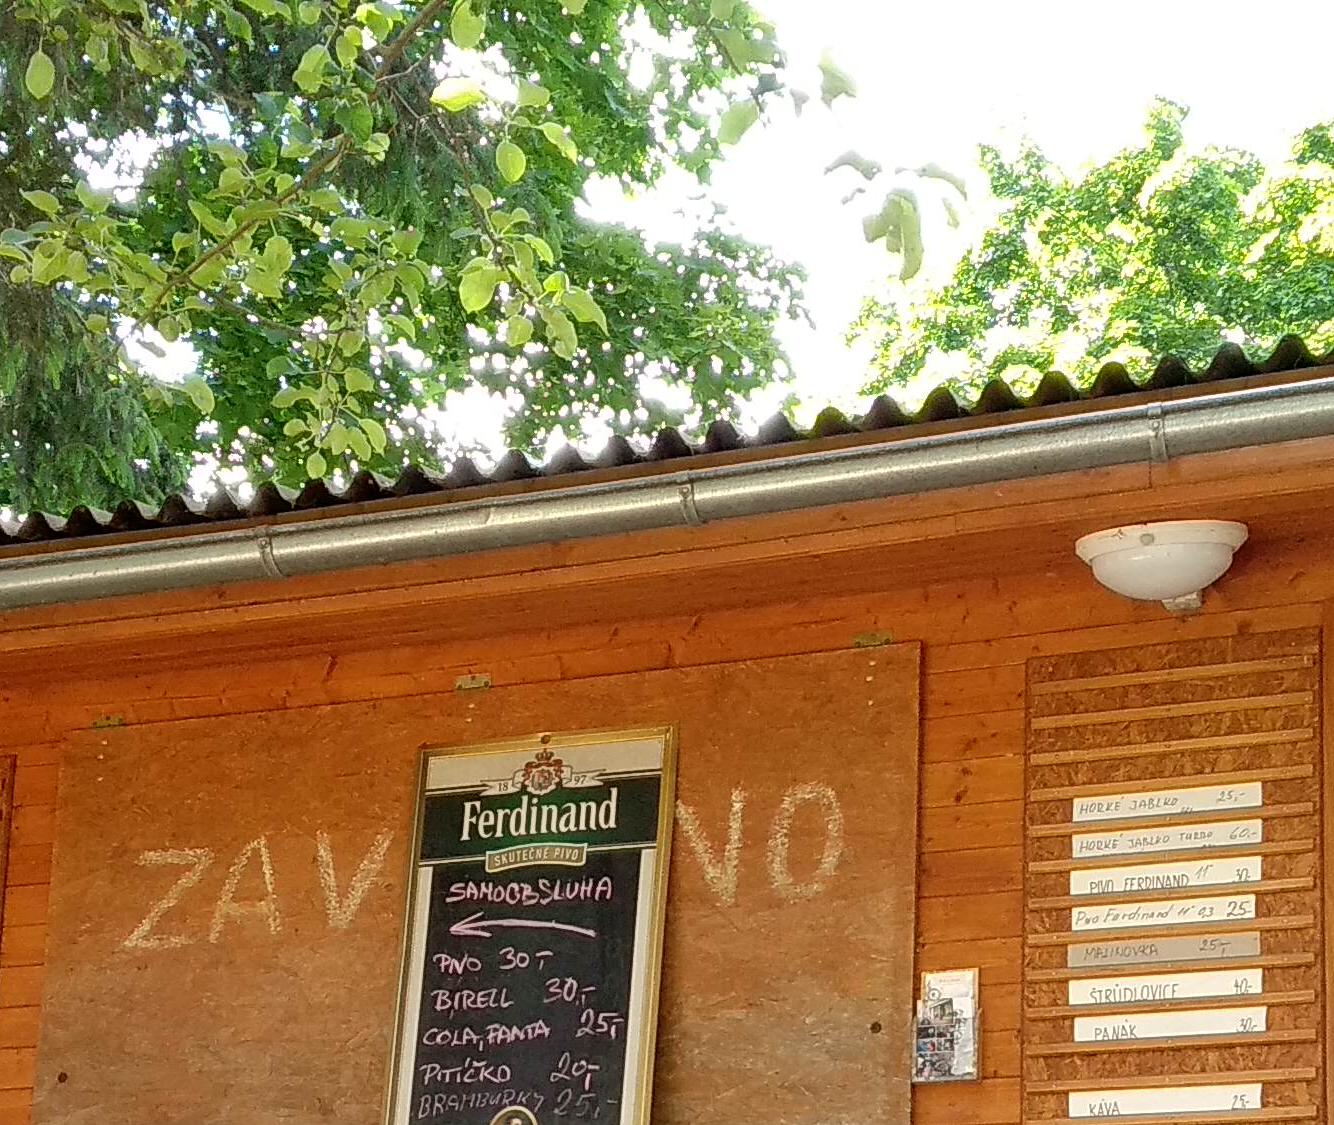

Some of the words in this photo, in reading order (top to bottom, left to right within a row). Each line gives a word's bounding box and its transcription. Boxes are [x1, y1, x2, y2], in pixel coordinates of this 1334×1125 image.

[498, 782, 509, 792] 18
[574, 775, 587, 784] 97
[460, 787, 618, 841] Ferdinand
[1079, 796, 1124, 814] HORKÉ
[1129, 797, 1179, 811] JABLKO
[1128, 836, 1170, 850] JABLKO
[494, 847, 548, 866] SKUTEČNÉ
[553, 848, 579, 861] PIVO
[445, 876, 612, 906] SAMOOBSLUHA
[1123, 873, 1190, 891] FERDINAND
[1103, 904, 1174, 922] Ferdinand
[431, 988, 515, 1014] BIRELL
[1094, 1018, 1139, 1040] PANÁK
[1088, 1098, 1121, 1117] KÁVA
